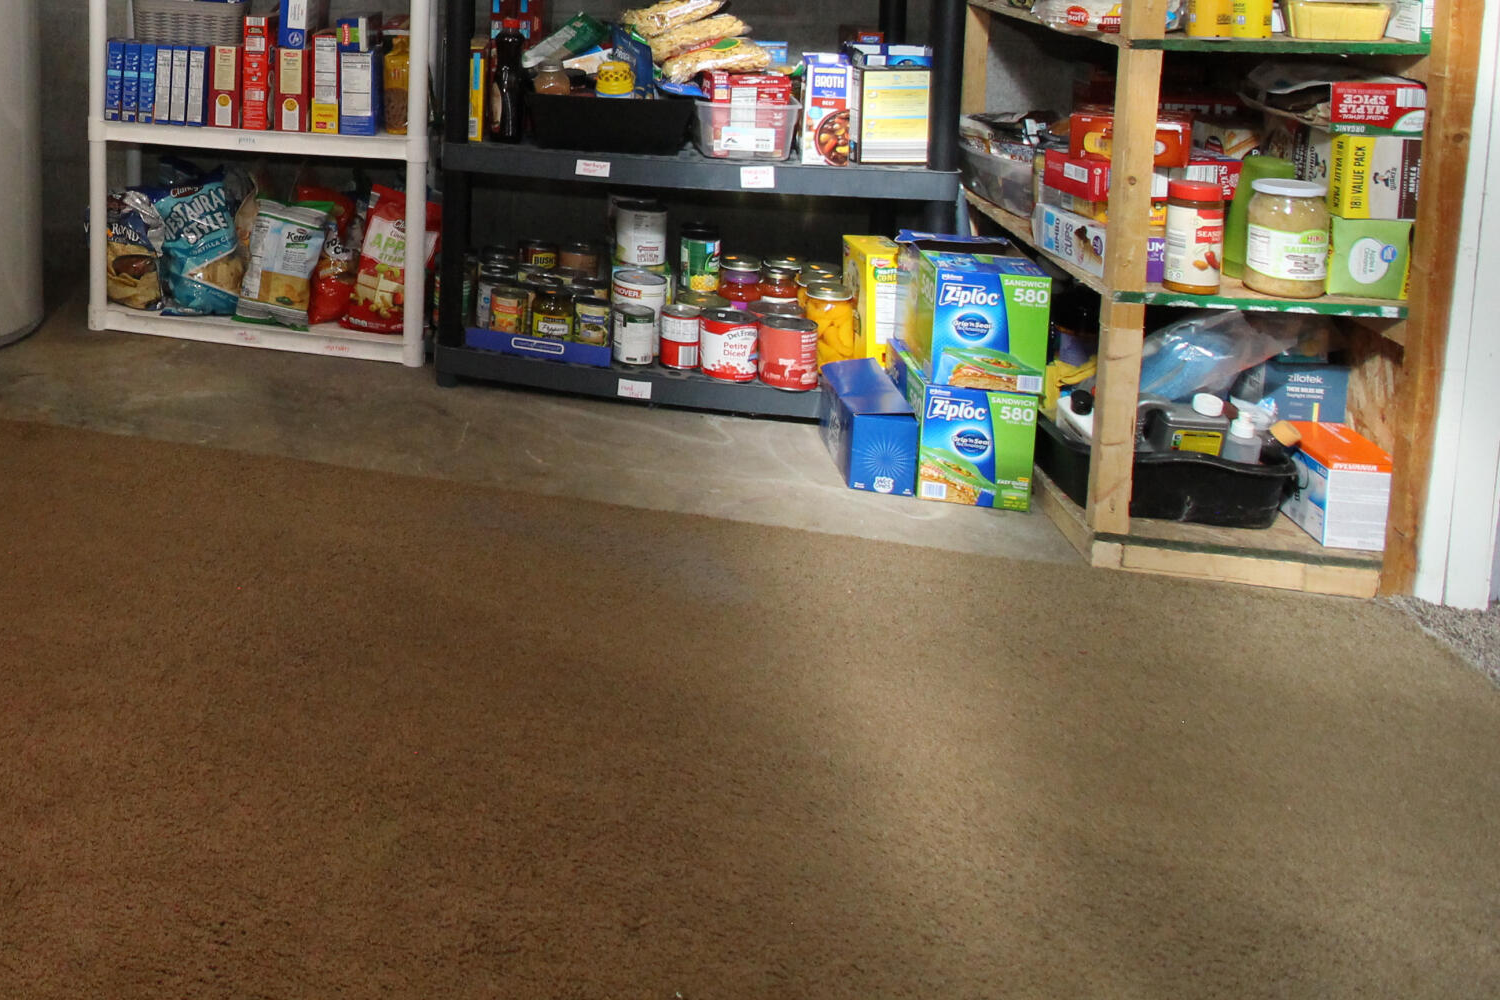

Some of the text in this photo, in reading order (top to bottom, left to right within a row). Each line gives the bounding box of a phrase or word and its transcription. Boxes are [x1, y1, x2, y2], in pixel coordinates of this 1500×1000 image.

[814, 76, 845, 88] BROTH
[1343, 94, 1387, 105] SPICE
[1339, 104, 1389, 114] MAPLE
[1355, 146, 1366, 165] PACK
[1218, 165, 1231, 196] SUGAR
[1352, 166, 1364, 195] VALUE
[183, 211, 227, 244] STYLE
[370, 233, 405, 256] APP
[1064, 222, 1074, 256] CUPS
[533, 256, 555, 265] BUSH
[1004, 279, 1050, 288] SANDWICH
[944, 286, 999, 307] Ziploc
[1014, 288, 1048, 303] 580
[724, 342, 748, 350] Petite
[1288, 374, 1324, 384] zilotek
[932, 398, 987, 421] Ziploc
[991, 397, 1036, 407] SANDWICH
[999, 407, 1035, 422] 580
